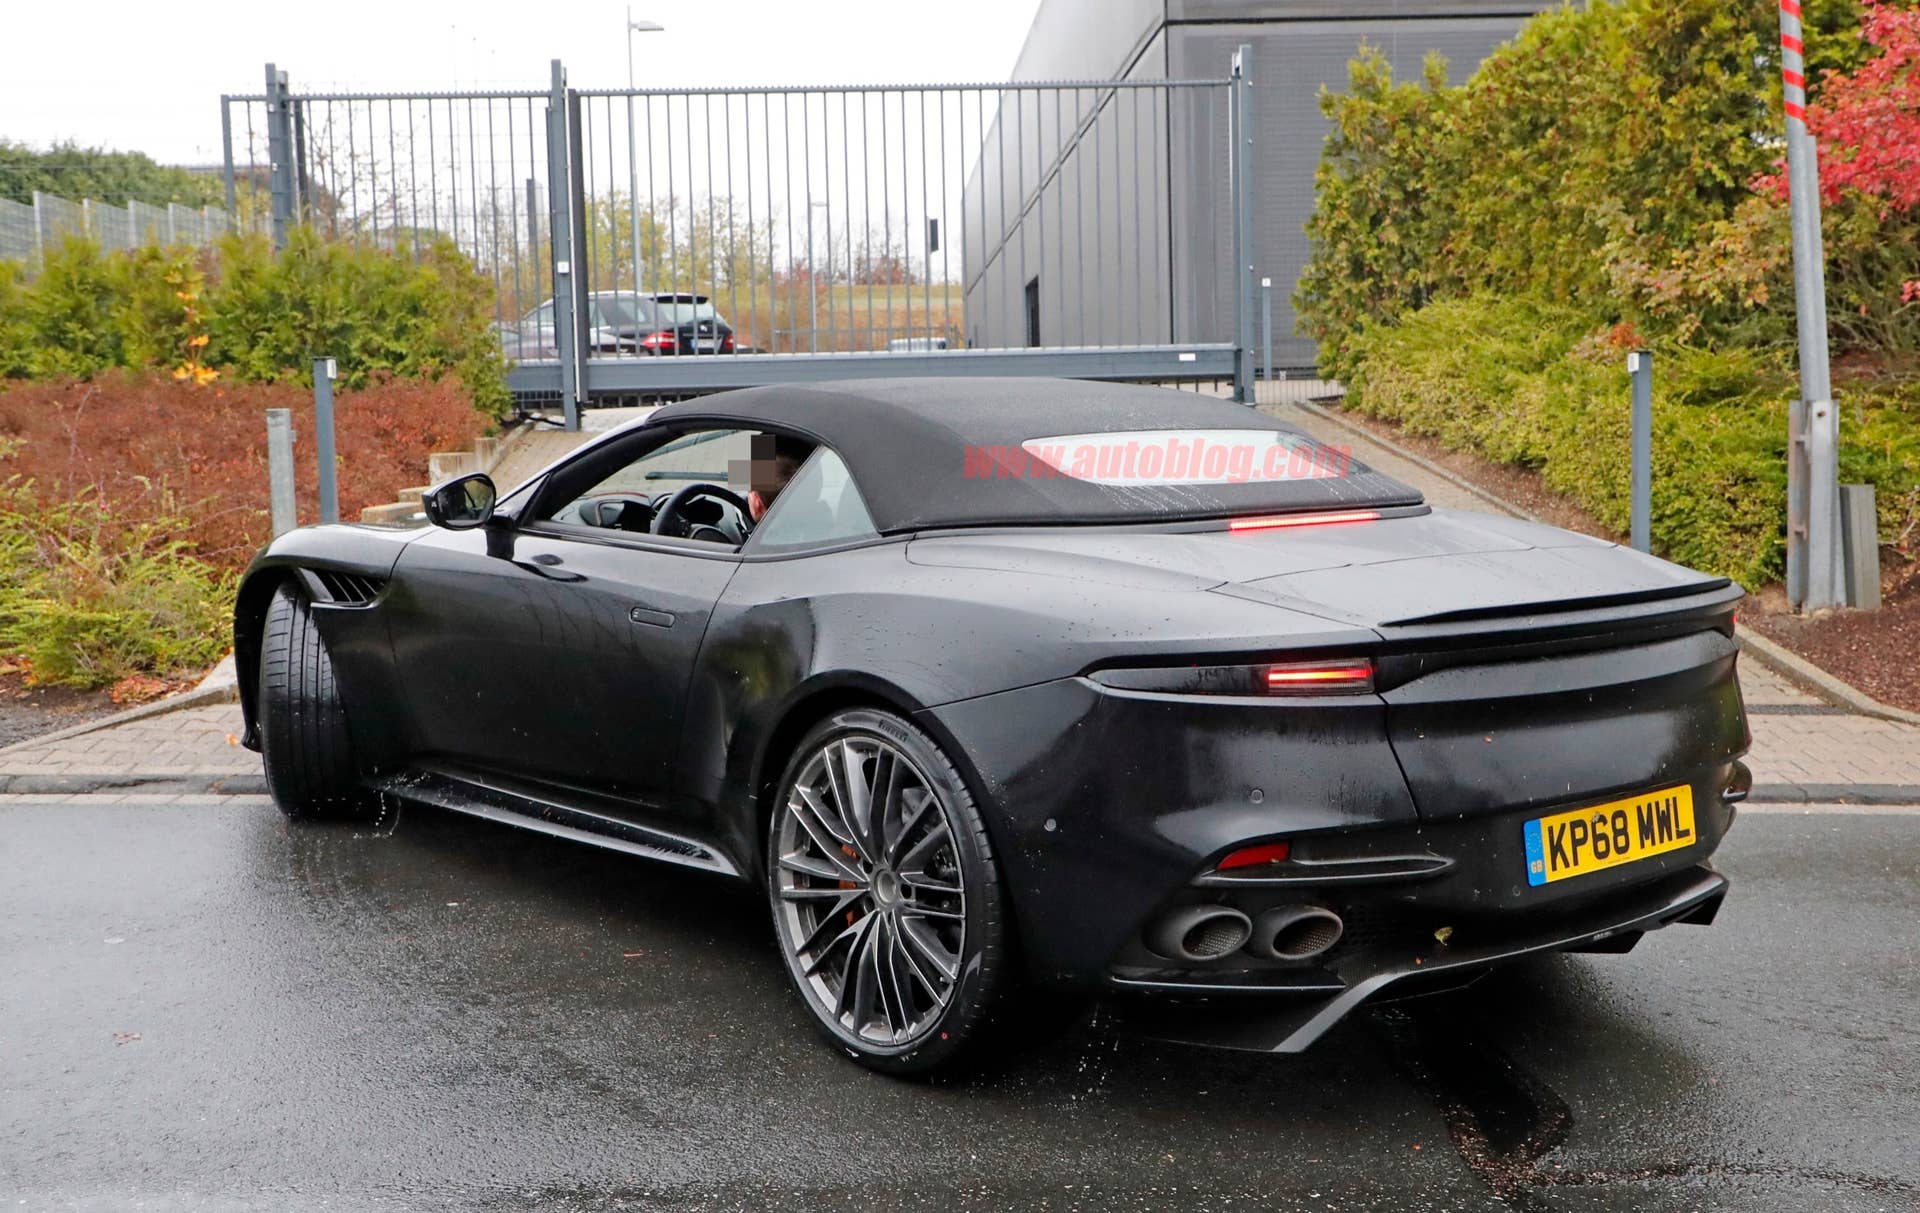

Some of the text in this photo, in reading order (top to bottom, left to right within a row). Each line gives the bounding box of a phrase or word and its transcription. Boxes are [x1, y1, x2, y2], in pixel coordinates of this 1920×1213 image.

[1548, 796, 1690, 871] KP68 MWL
[1531, 860, 1543, 873] GB
